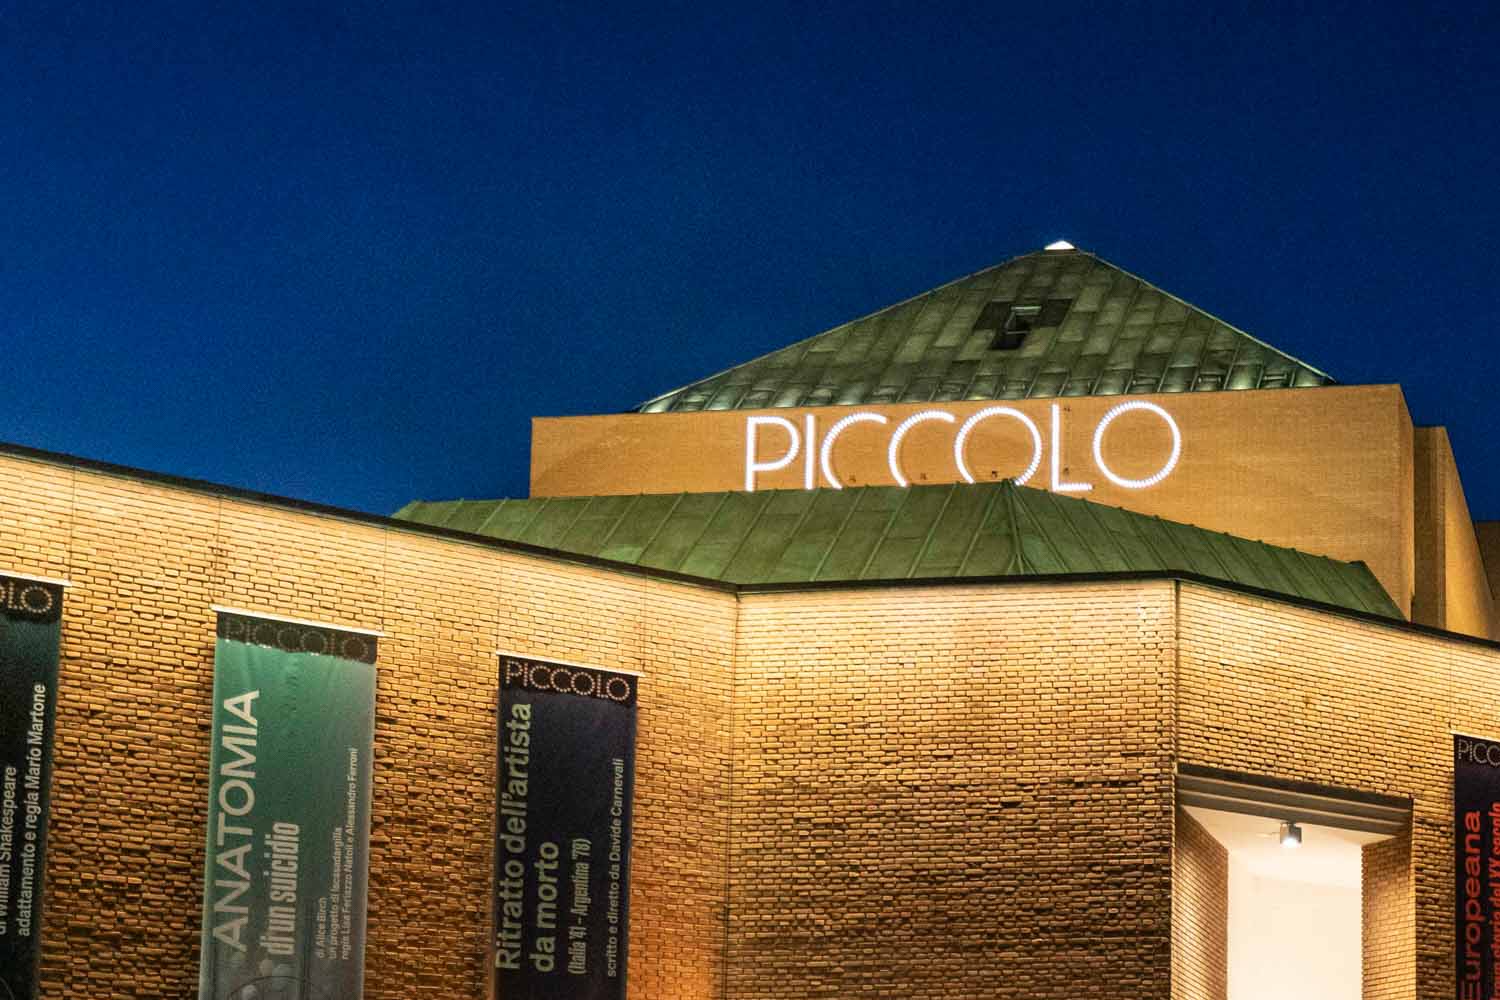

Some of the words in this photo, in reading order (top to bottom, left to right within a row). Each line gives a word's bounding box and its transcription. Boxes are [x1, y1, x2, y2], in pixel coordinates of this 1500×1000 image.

[745, 401, 1181, 492] PICCOLO
[0, 581, 52, 613] LO
[505, 660, 631, 702] PICCOLO
[28, 683, 46, 745] Martone
[24, 747, 42, 790] Mario
[500, 704, 533, 854] dell'artista
[610, 757, 624, 816] Carnevali
[0, 766, 17, 862] Shakespeare
[24, 792, 41, 830] regia
[212, 688, 260, 952] ANATOMIA
[25, 831, 36, 842] e
[609, 819, 622, 862] Davide
[263, 821, 300, 902] suicidio
[609, 863, 621, 880] da
[16, 843, 36, 937] adattamento
[533, 841, 560, 928] morto
[570, 861, 592, 917] Argentina
[607, 881, 620, 925] diretto
[269, 906, 296, 933] un
[495, 860, 525, 970] Ritratto
[260, 934, 295, 956] di
[528, 936, 555, 973] da
[606, 935, 618, 978] scritto
